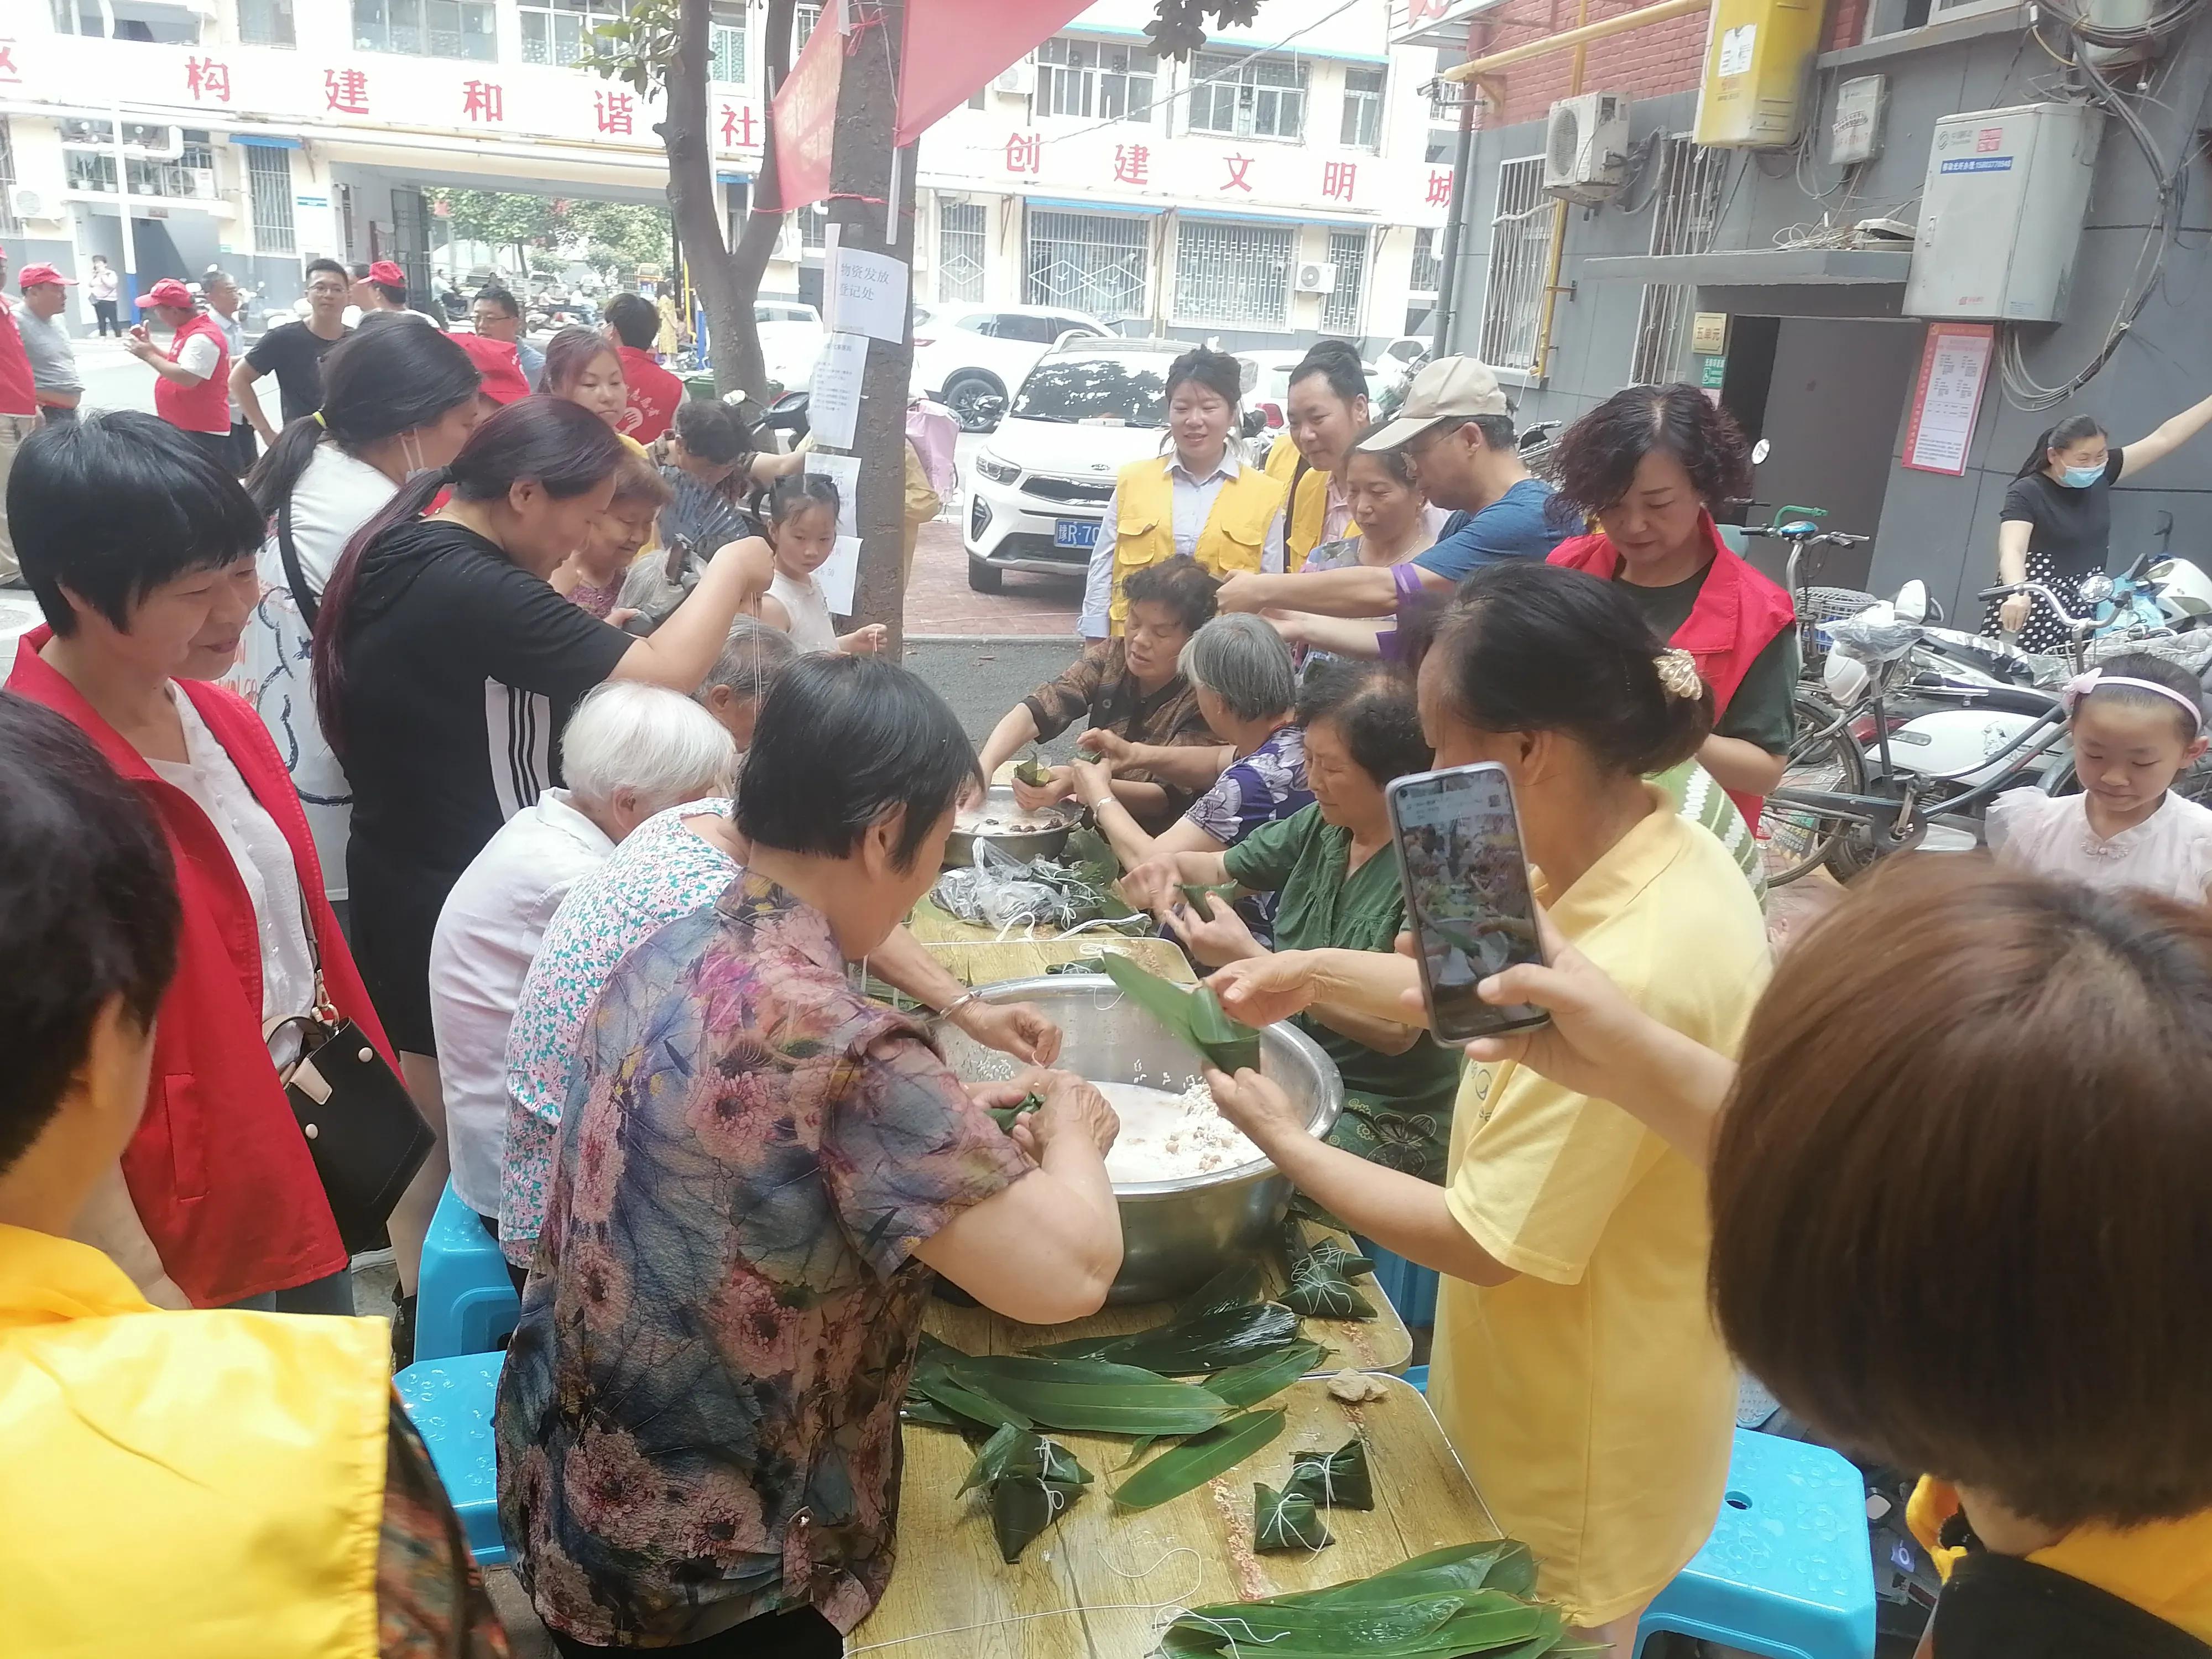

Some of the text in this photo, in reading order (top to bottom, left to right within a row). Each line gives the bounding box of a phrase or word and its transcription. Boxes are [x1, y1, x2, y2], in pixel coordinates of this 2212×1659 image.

[841, 263, 889, 284] 物资发放
[839, 283, 874, 301] 登记处
